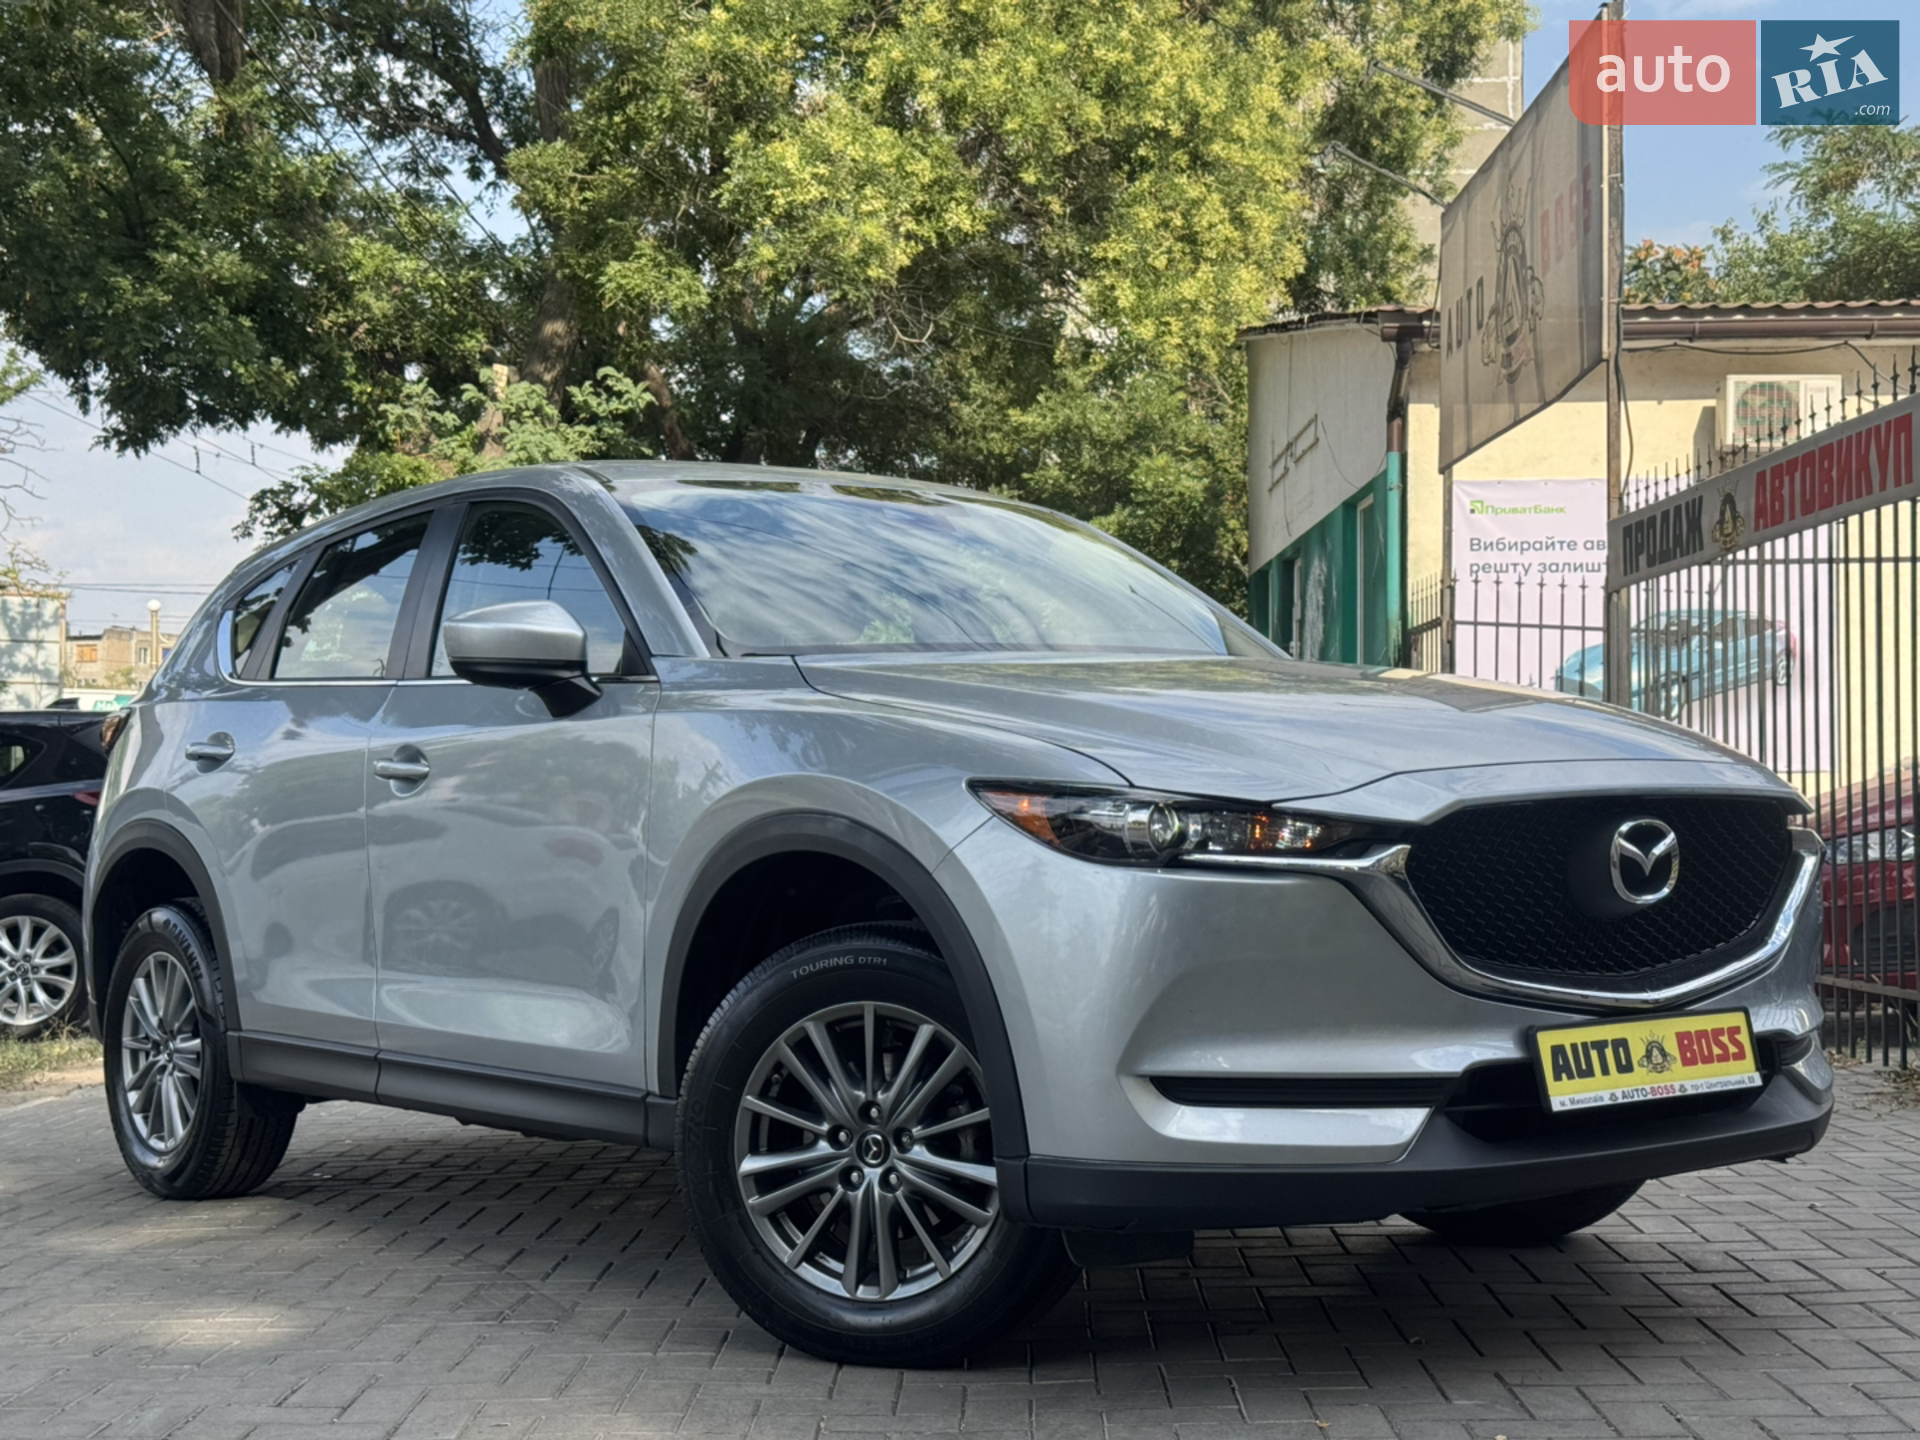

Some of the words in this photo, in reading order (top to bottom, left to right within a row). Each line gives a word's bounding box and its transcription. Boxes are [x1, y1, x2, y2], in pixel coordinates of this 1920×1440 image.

[1446, 276, 1484, 360] AUTO
[1622, 495, 1704, 577] ПРОДАЖ
[1754, 412, 1913, 532] АВТОВИКУП
[1485, 504, 1566, 516] ПриватБанк
[1469, 535, 1578, 555] Вибирайте
[1583, 539, 1607, 551] ав
[1469, 562, 1532, 577] решту
[790, 956, 854, 979] TOURING
[1550, 1037, 1634, 1082] AUTO
[1675, 1026, 1747, 1067] BOSS
[1621, 1084, 1676, 1100] AUTO-BOSS
